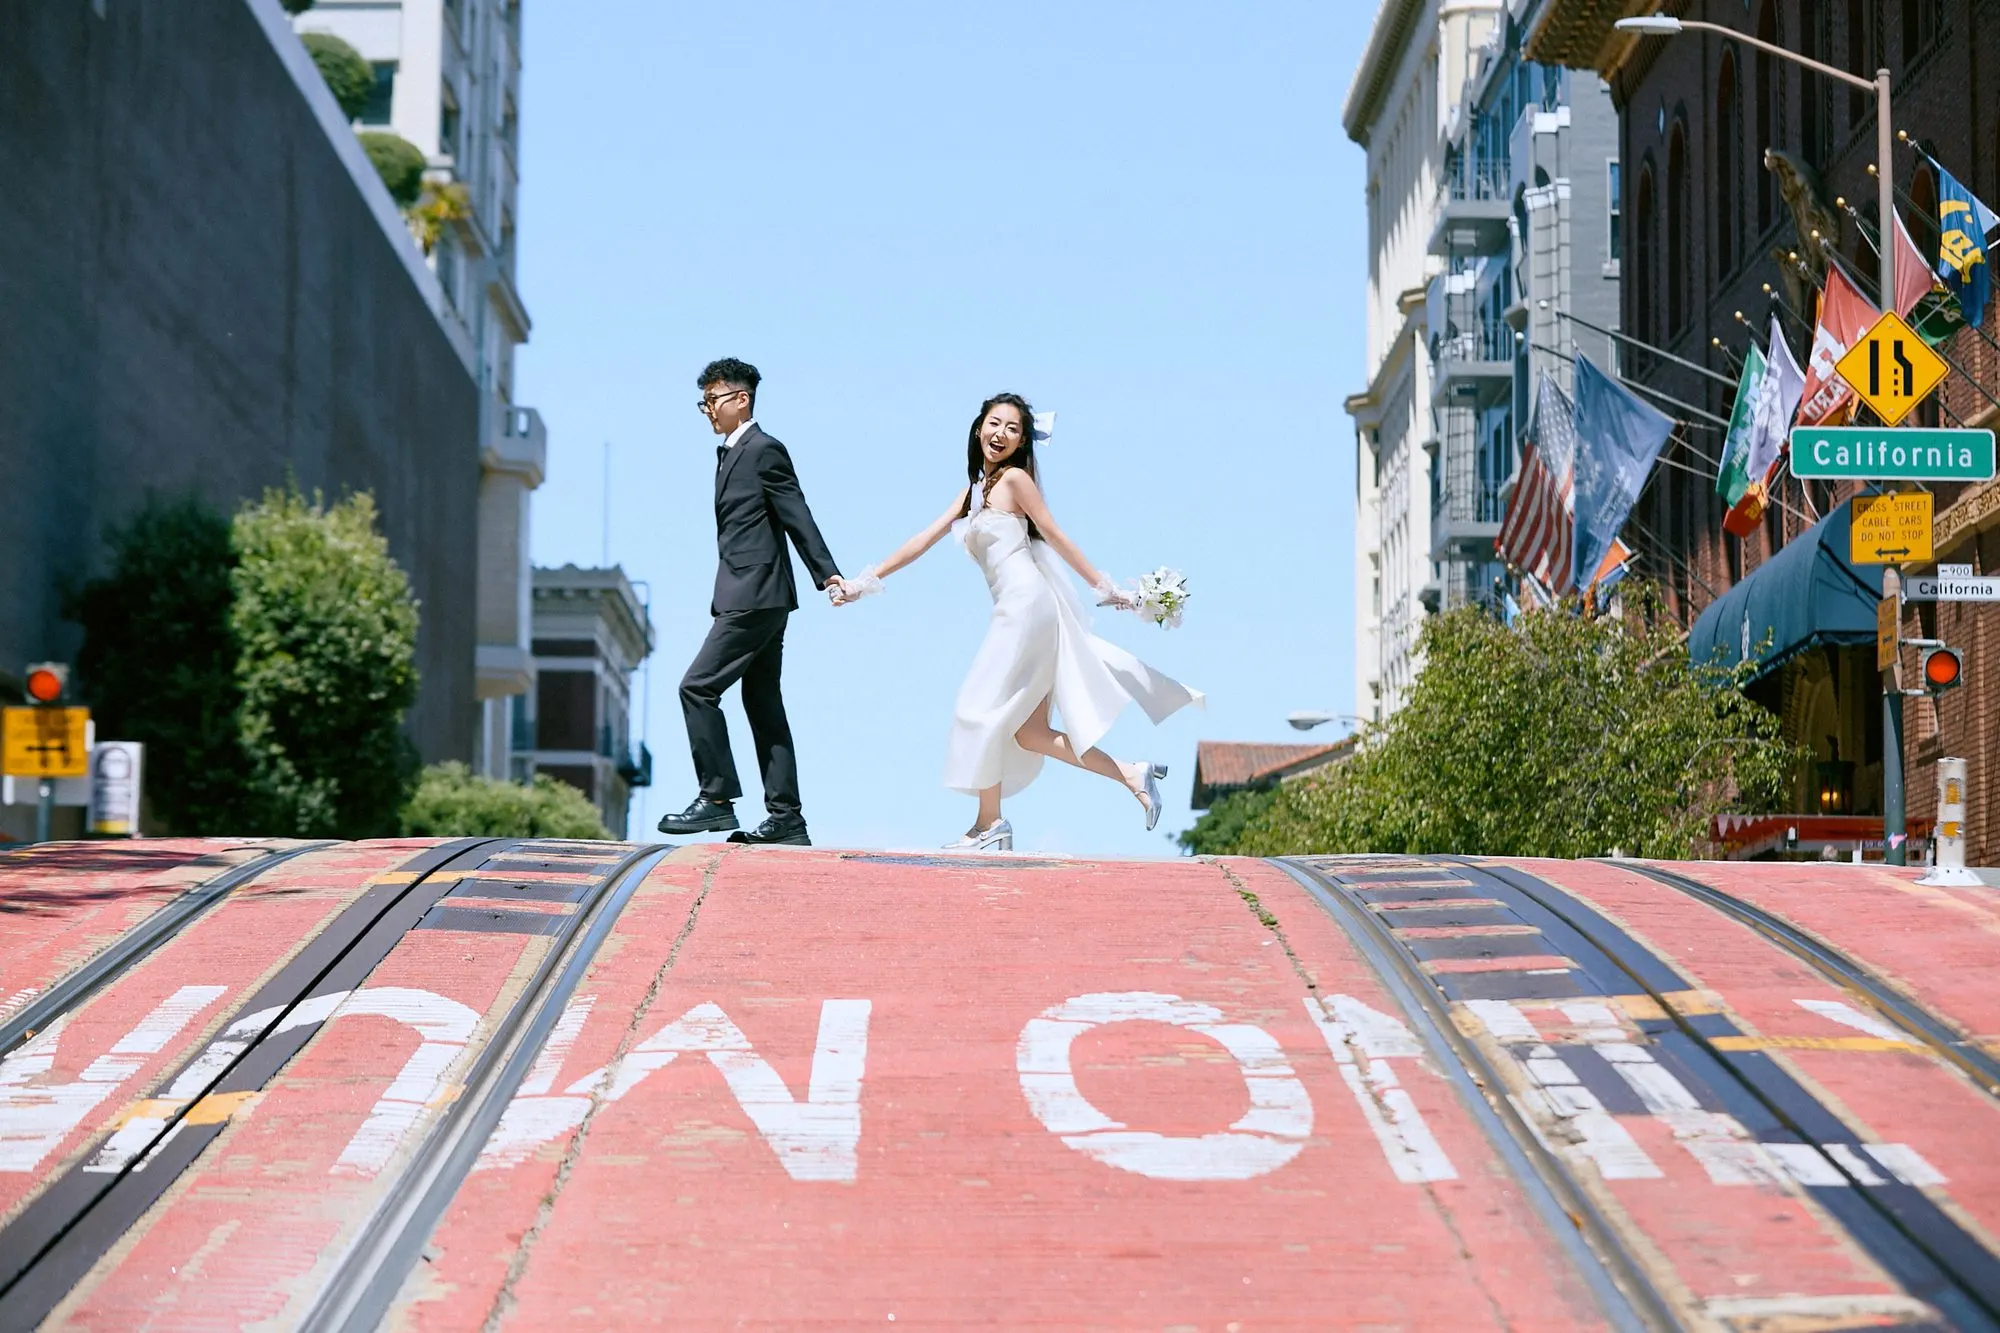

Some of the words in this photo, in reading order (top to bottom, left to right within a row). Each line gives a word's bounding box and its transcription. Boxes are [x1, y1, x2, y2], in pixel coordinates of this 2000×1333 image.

[1813, 440, 1973, 467] California
[1857, 503, 1887, 514] CROSS
[1894, 500, 1927, 512] STREET
[1862, 517, 1891, 527] CABLE
[1899, 515, 1922, 526] CARS
[1861, 532, 1873, 542] DO
[1879, 531, 1895, 541] NOT
[1902, 530, 1924, 541] STOP
[1919, 582, 1993, 595] California
